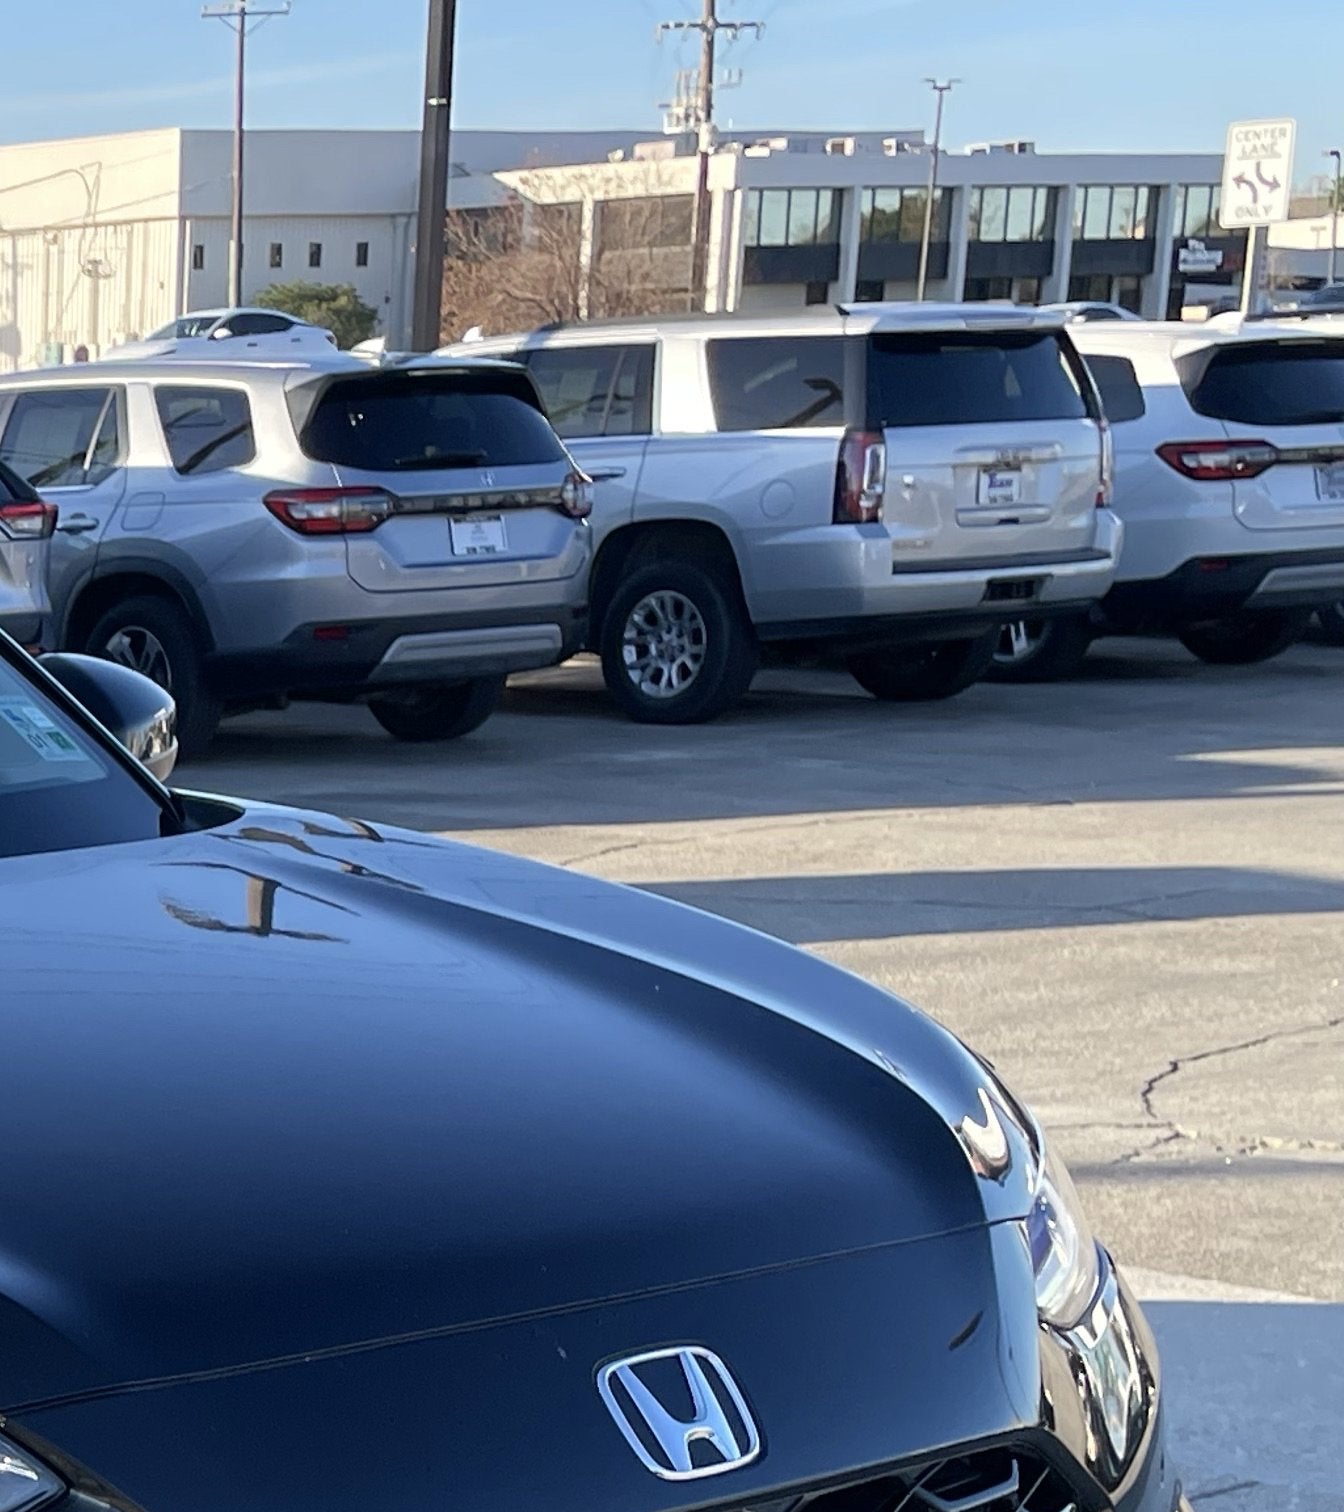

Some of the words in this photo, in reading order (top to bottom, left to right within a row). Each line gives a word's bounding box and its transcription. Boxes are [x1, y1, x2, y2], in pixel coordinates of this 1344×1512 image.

[1235, 127, 1287, 142] CENTER
[1239, 141, 1279, 157] LANE
[1235, 204, 1273, 218] ONLY
